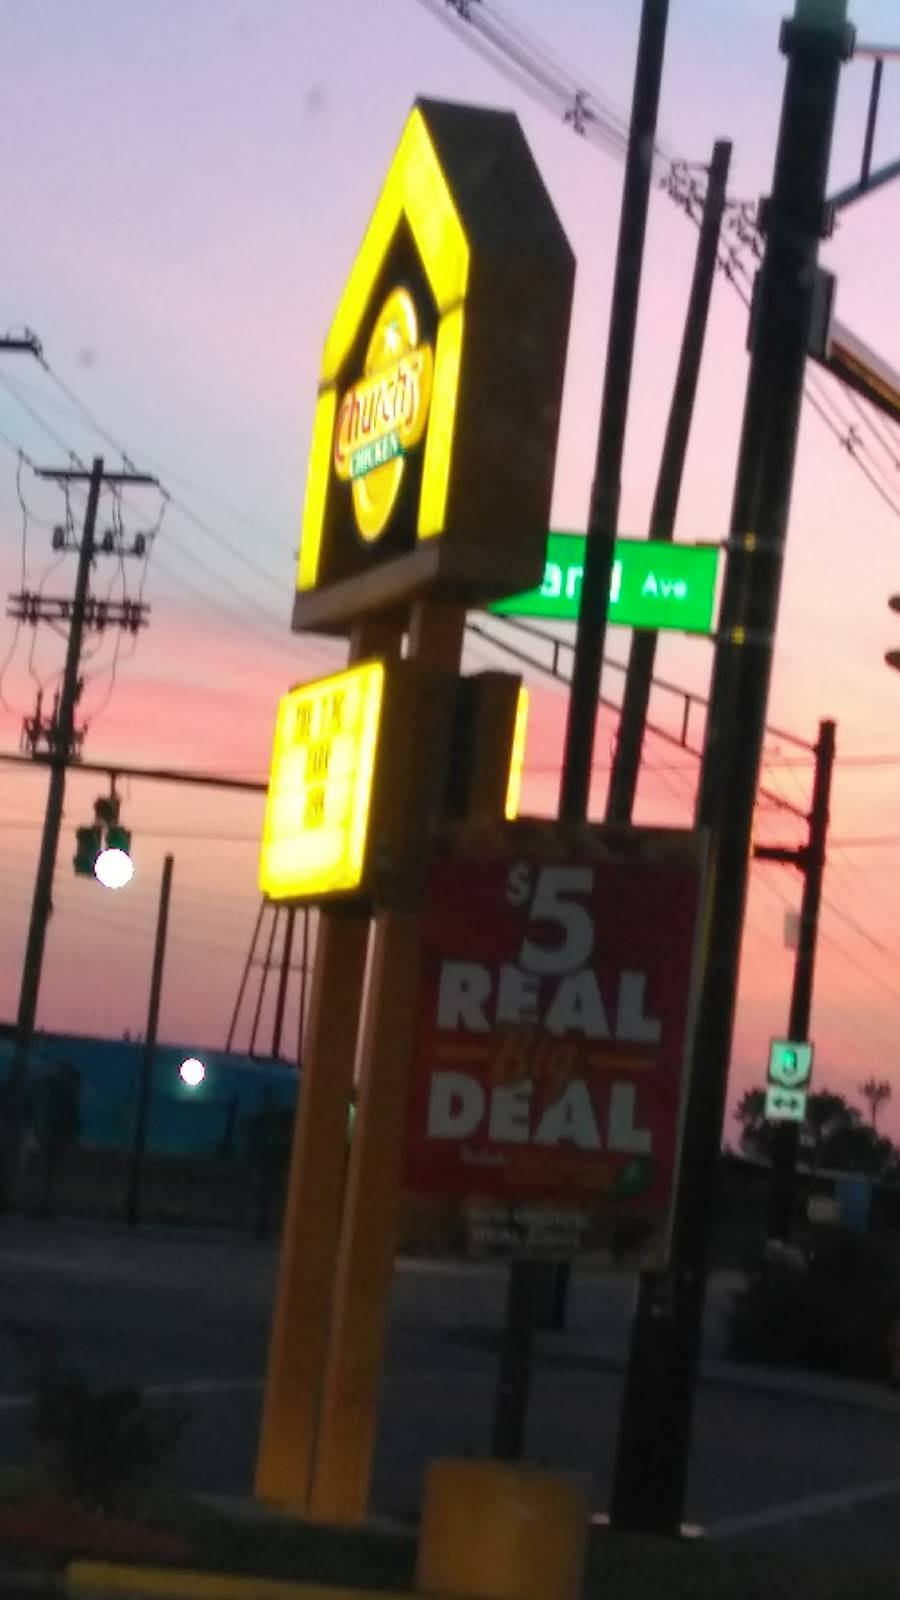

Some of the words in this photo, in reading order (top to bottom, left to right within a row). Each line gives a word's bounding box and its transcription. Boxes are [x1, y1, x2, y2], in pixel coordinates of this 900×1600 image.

[641, 571, 688, 599] Ave
[437, 958, 662, 1042] REAL
[426, 1071, 652, 1154] DEAL
